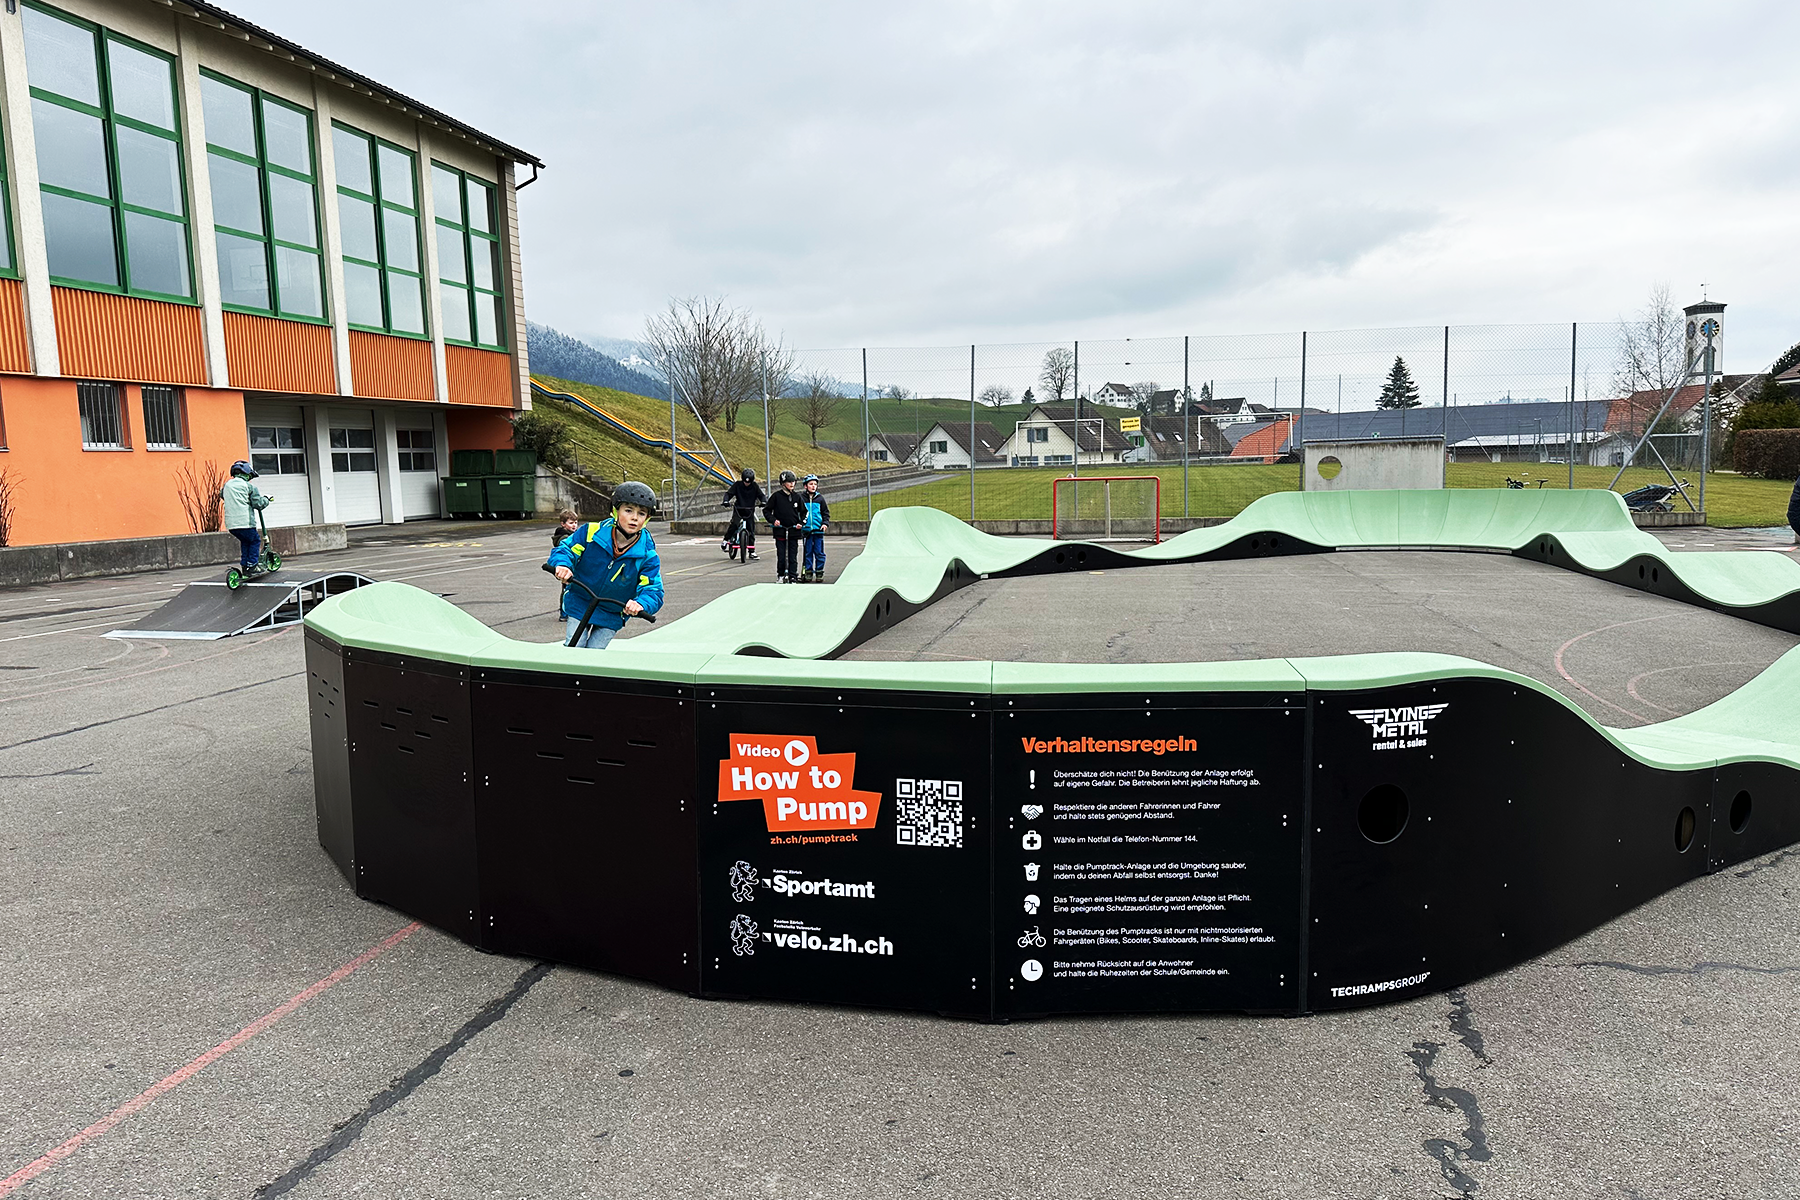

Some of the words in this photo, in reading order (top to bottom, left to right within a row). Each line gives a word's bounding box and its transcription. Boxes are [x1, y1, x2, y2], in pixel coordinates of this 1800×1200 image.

[1374, 706, 1429, 723] FLYING
[1372, 721, 1428, 738] METAL
[1021, 735, 1197, 756] Verhaltensregeln
[1373, 740, 1397, 750] rental
[1399, 739, 1406, 749] &
[1407, 738, 1427, 748] sales
[736, 743, 781, 760] Video
[731, 765, 800, 791] How
[808, 765, 842, 790] to
[1053, 769, 1098, 778] Überschätze
[1099, 770, 1115, 778] dich
[1116, 770, 1137, 778] nicht!
[1137, 769, 1150, 777] Die
[1151, 769, 1190, 778] Benützung
[1190, 769, 1203, 777] der
[1204, 769, 1229, 778] Anlage
[1230, 769, 1254, 778] erfolgt
[1053, 780, 1065, 788] auf
[1066, 780, 1091, 789] eigene
[1091, 779, 1117, 787] Gefahr.
[1118, 779, 1131, 787] Die
[1131, 778, 1171, 787] Betreiberin
[1171, 778, 1190, 786] lehnt
[1190, 778, 1218, 788] jegliche
[1219, 778, 1248, 787] Haftung
[1249, 778, 1261, 786] ab.
[775, 796, 868, 825] Pump
[1053, 803, 1096, 812] Respektiere
[1096, 803, 1108, 811] die
[1108, 803, 1138, 811] anderen
[1139, 802, 1181, 810] Fahrerinnen
[1182, 802, 1197, 810] und
[1197, 802, 1221, 810] Fahrer
[1068, 812, 1087, 820] halte
[1087, 812, 1106, 820] stets
[1106, 812, 1142, 821] genügend
[1142, 811, 1175, 819] Abstand.
[770, 833, 858, 845] zh.ch/pumptrack
[1053, 836, 1076, 844] Wähle
[1087, 835, 1111, 843] Notfall
[1124, 835, 1183, 843] Telefon-Nummer
[1053, 863, 1072, 871] Halte
[1073, 863, 1085, 871] die
[1086, 862, 1151, 871] Pumptrack-Anlage
[1152, 862, 1167, 870] und
[1167, 862, 1179, 870] die
[1180, 862, 1220, 871] Umgebung
[1220, 861, 1247, 870] sauber,
[1053, 872, 1076, 880] indem
[1076, 872, 1087, 880] du
[1087, 872, 1112, 880] deinen
[1112, 871, 1134, 879] Abfall
[1134, 871, 1156, 879] selbst
[1157, 871, 1192, 880] entsorgst.
[1193, 870, 1219, 879] Danke!
[773, 874, 875, 899] Sportamt
[1053, 895, 1068, 904] Das
[1068, 895, 1093, 905] Tragen
[1093, 895, 1113, 903] eines
[1114, 895, 1137, 903] Helms
[1138, 894, 1150, 902] auf
[1164, 895, 1191, 904] ganzen
[1191, 894, 1216, 903] Anlage
[1217, 894, 1226, 902] ist
[1227, 894, 1252, 902] Pflicht.
[1053, 905, 1069, 913] Eine
[1070, 905, 1105, 914] geeignete
[1105, 904, 1169, 913] Schutzausrüstung
[1170, 903, 1186, 911] wird
[1186, 903, 1226, 912] empfohlen.
[1053, 928, 1066, 936] Die
[1066, 928, 1105, 937] Benützung
[1120, 927, 1163, 936] Pumptracks
[1163, 927, 1173, 935] ist
[1200, 926, 1263, 934] nichtmotorisierten
[773, 931, 894, 956] velo.zh.ch
[1053, 937, 1096, 946] Fahrgeräten
[1096, 936, 1121, 946] (Bikes,
[1122, 936, 1152, 944] Scooter,
[1152, 936, 1199, 944] Skateboards,
[1200, 935, 1249, 944] Inline-Skates)
[1249, 935, 1276, 943] erlaubt.
[1053, 960, 1071, 969] Bitte
[1071, 960, 1096, 968] nehme
[1096, 960, 1132, 968] Rücksicht
[1132, 959, 1145, 967] auf
[1157, 959, 1194, 967] Anwohner
[1053, 970, 1067, 978] und
[1099, 969, 1139, 977] Ruhezeiten
[1153, 968, 1216, 976] Schule/Gemeinde
